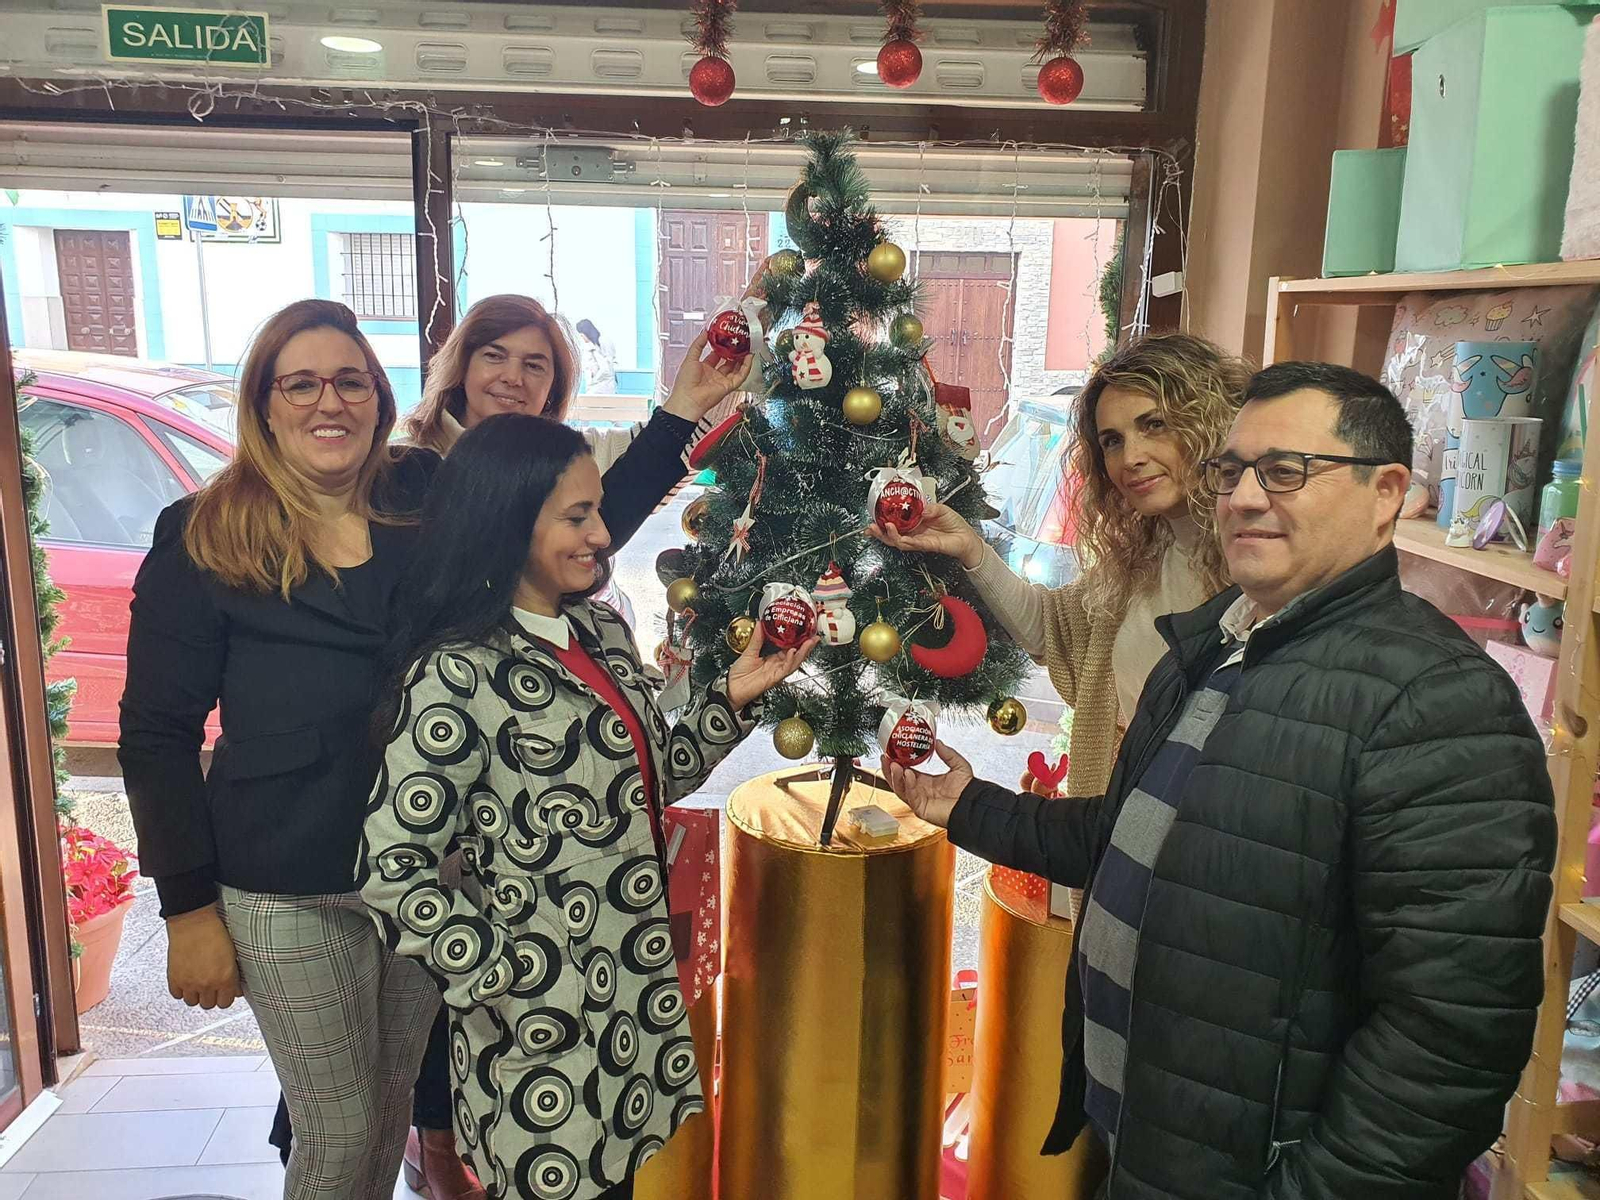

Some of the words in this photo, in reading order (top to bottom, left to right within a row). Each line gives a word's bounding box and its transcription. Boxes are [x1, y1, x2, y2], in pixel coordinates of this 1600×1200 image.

[122, 22, 257, 51] SALIDA
[771, 606, 806, 620] Empresas
[772, 613, 804, 626] Chiclana
